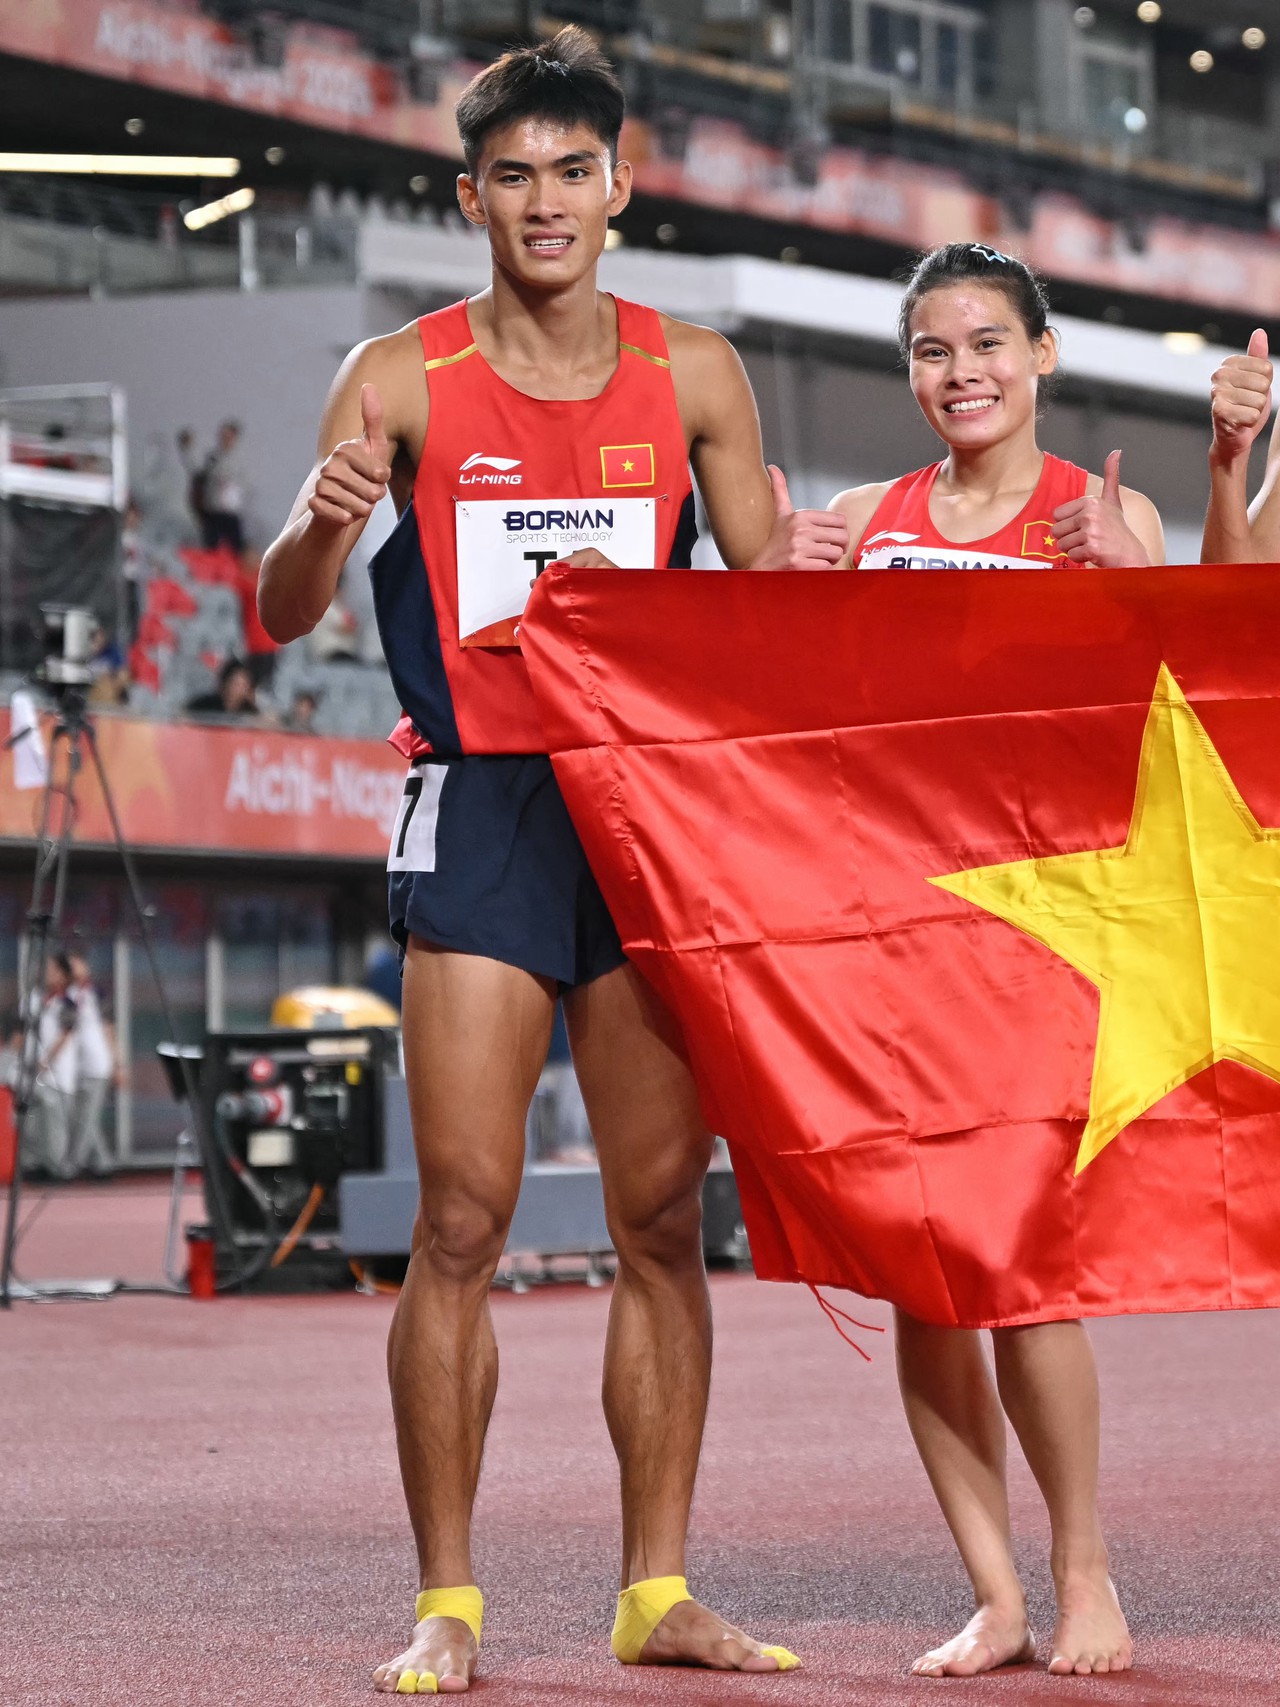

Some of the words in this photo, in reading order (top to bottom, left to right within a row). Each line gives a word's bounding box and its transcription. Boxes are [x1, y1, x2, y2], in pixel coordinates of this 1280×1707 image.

[459, 473, 522, 485] LI-NING
[502, 508, 614, 531] BORNAN
[506, 533, 548, 543] SPORTS
[552, 531, 614, 543] TECHNOLOGY
[395, 776, 423, 858] 7
